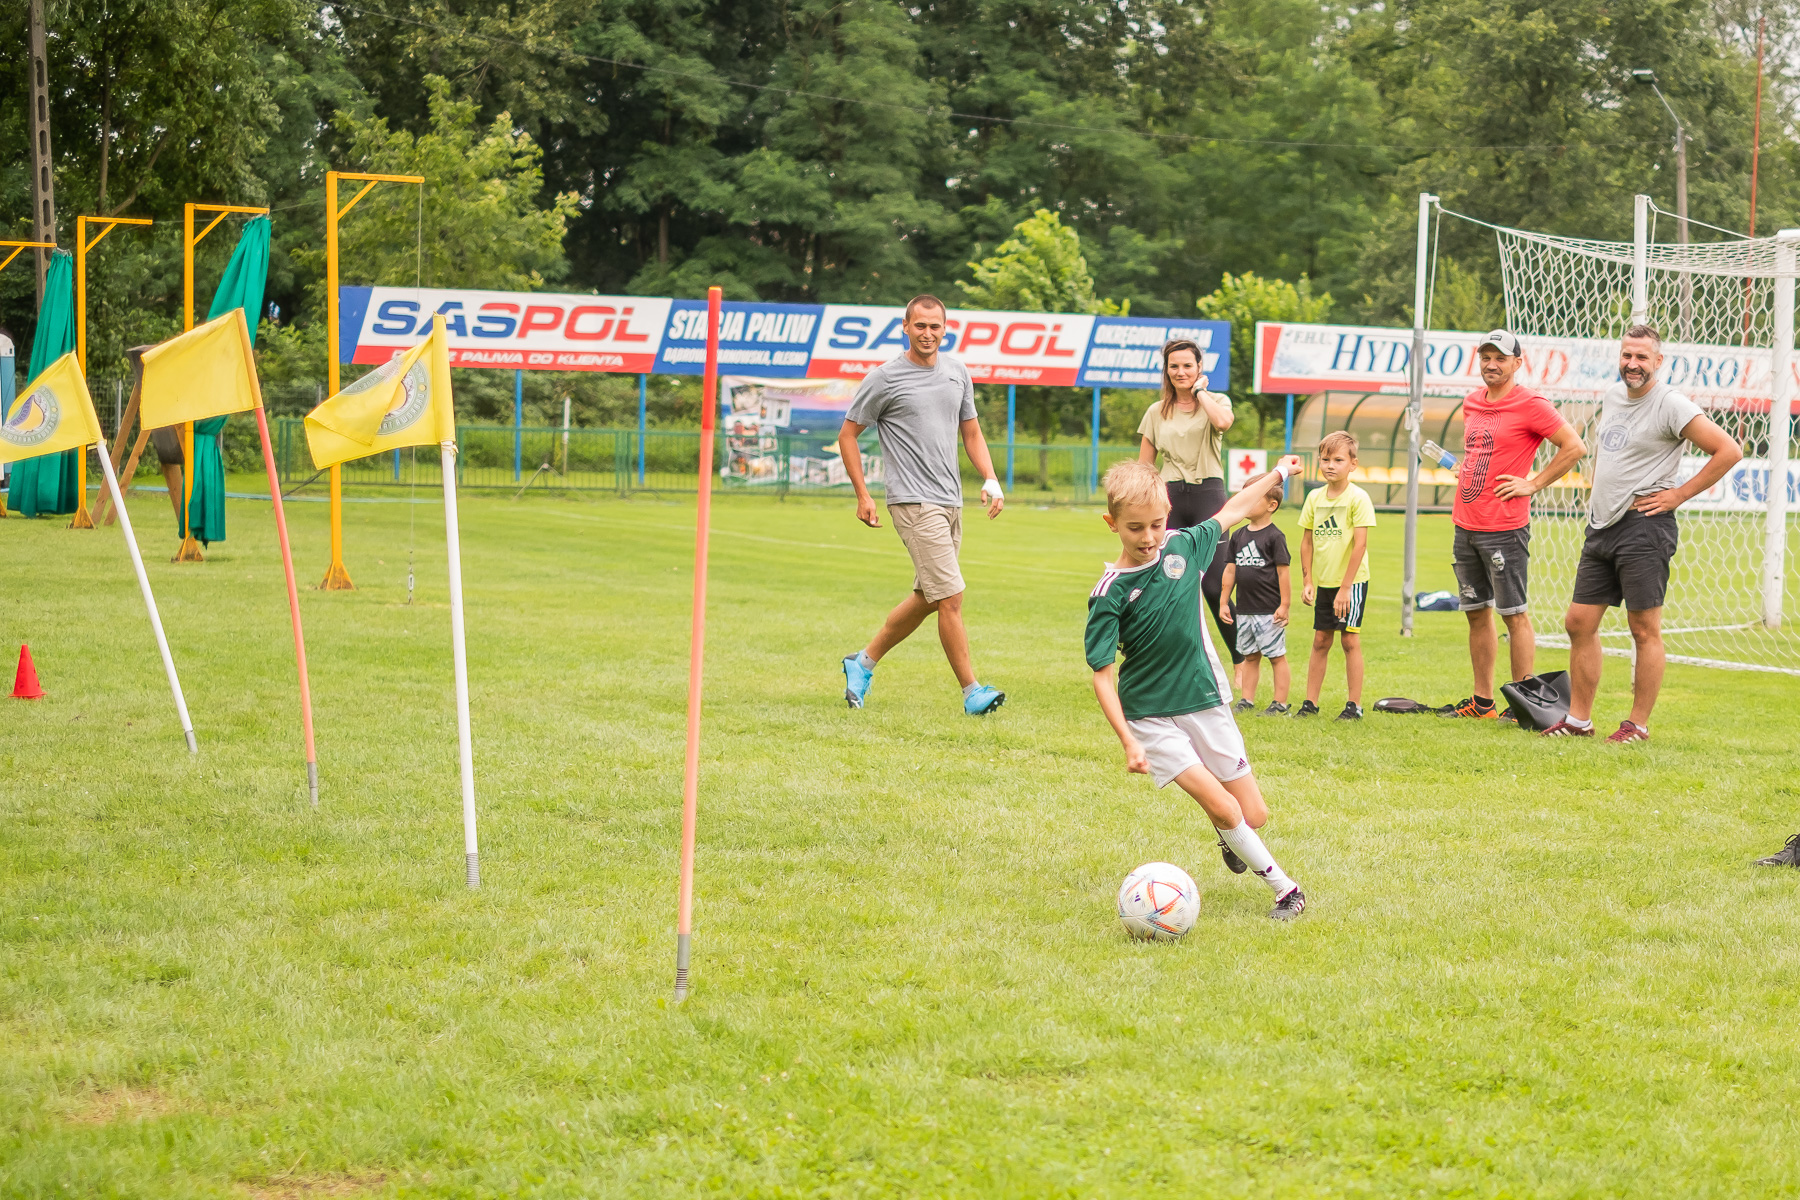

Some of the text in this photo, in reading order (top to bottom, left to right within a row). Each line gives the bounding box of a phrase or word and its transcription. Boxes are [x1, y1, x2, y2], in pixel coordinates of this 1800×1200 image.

[372, 300, 649, 342] SASPOL
[744, 312, 817, 343] PALIW
[460, 351, 524, 364] PALIWA
[527, 353, 554, 365] DO
[557, 354, 624, 367] KLIENTA
[1315, 527, 1342, 536] adidas
